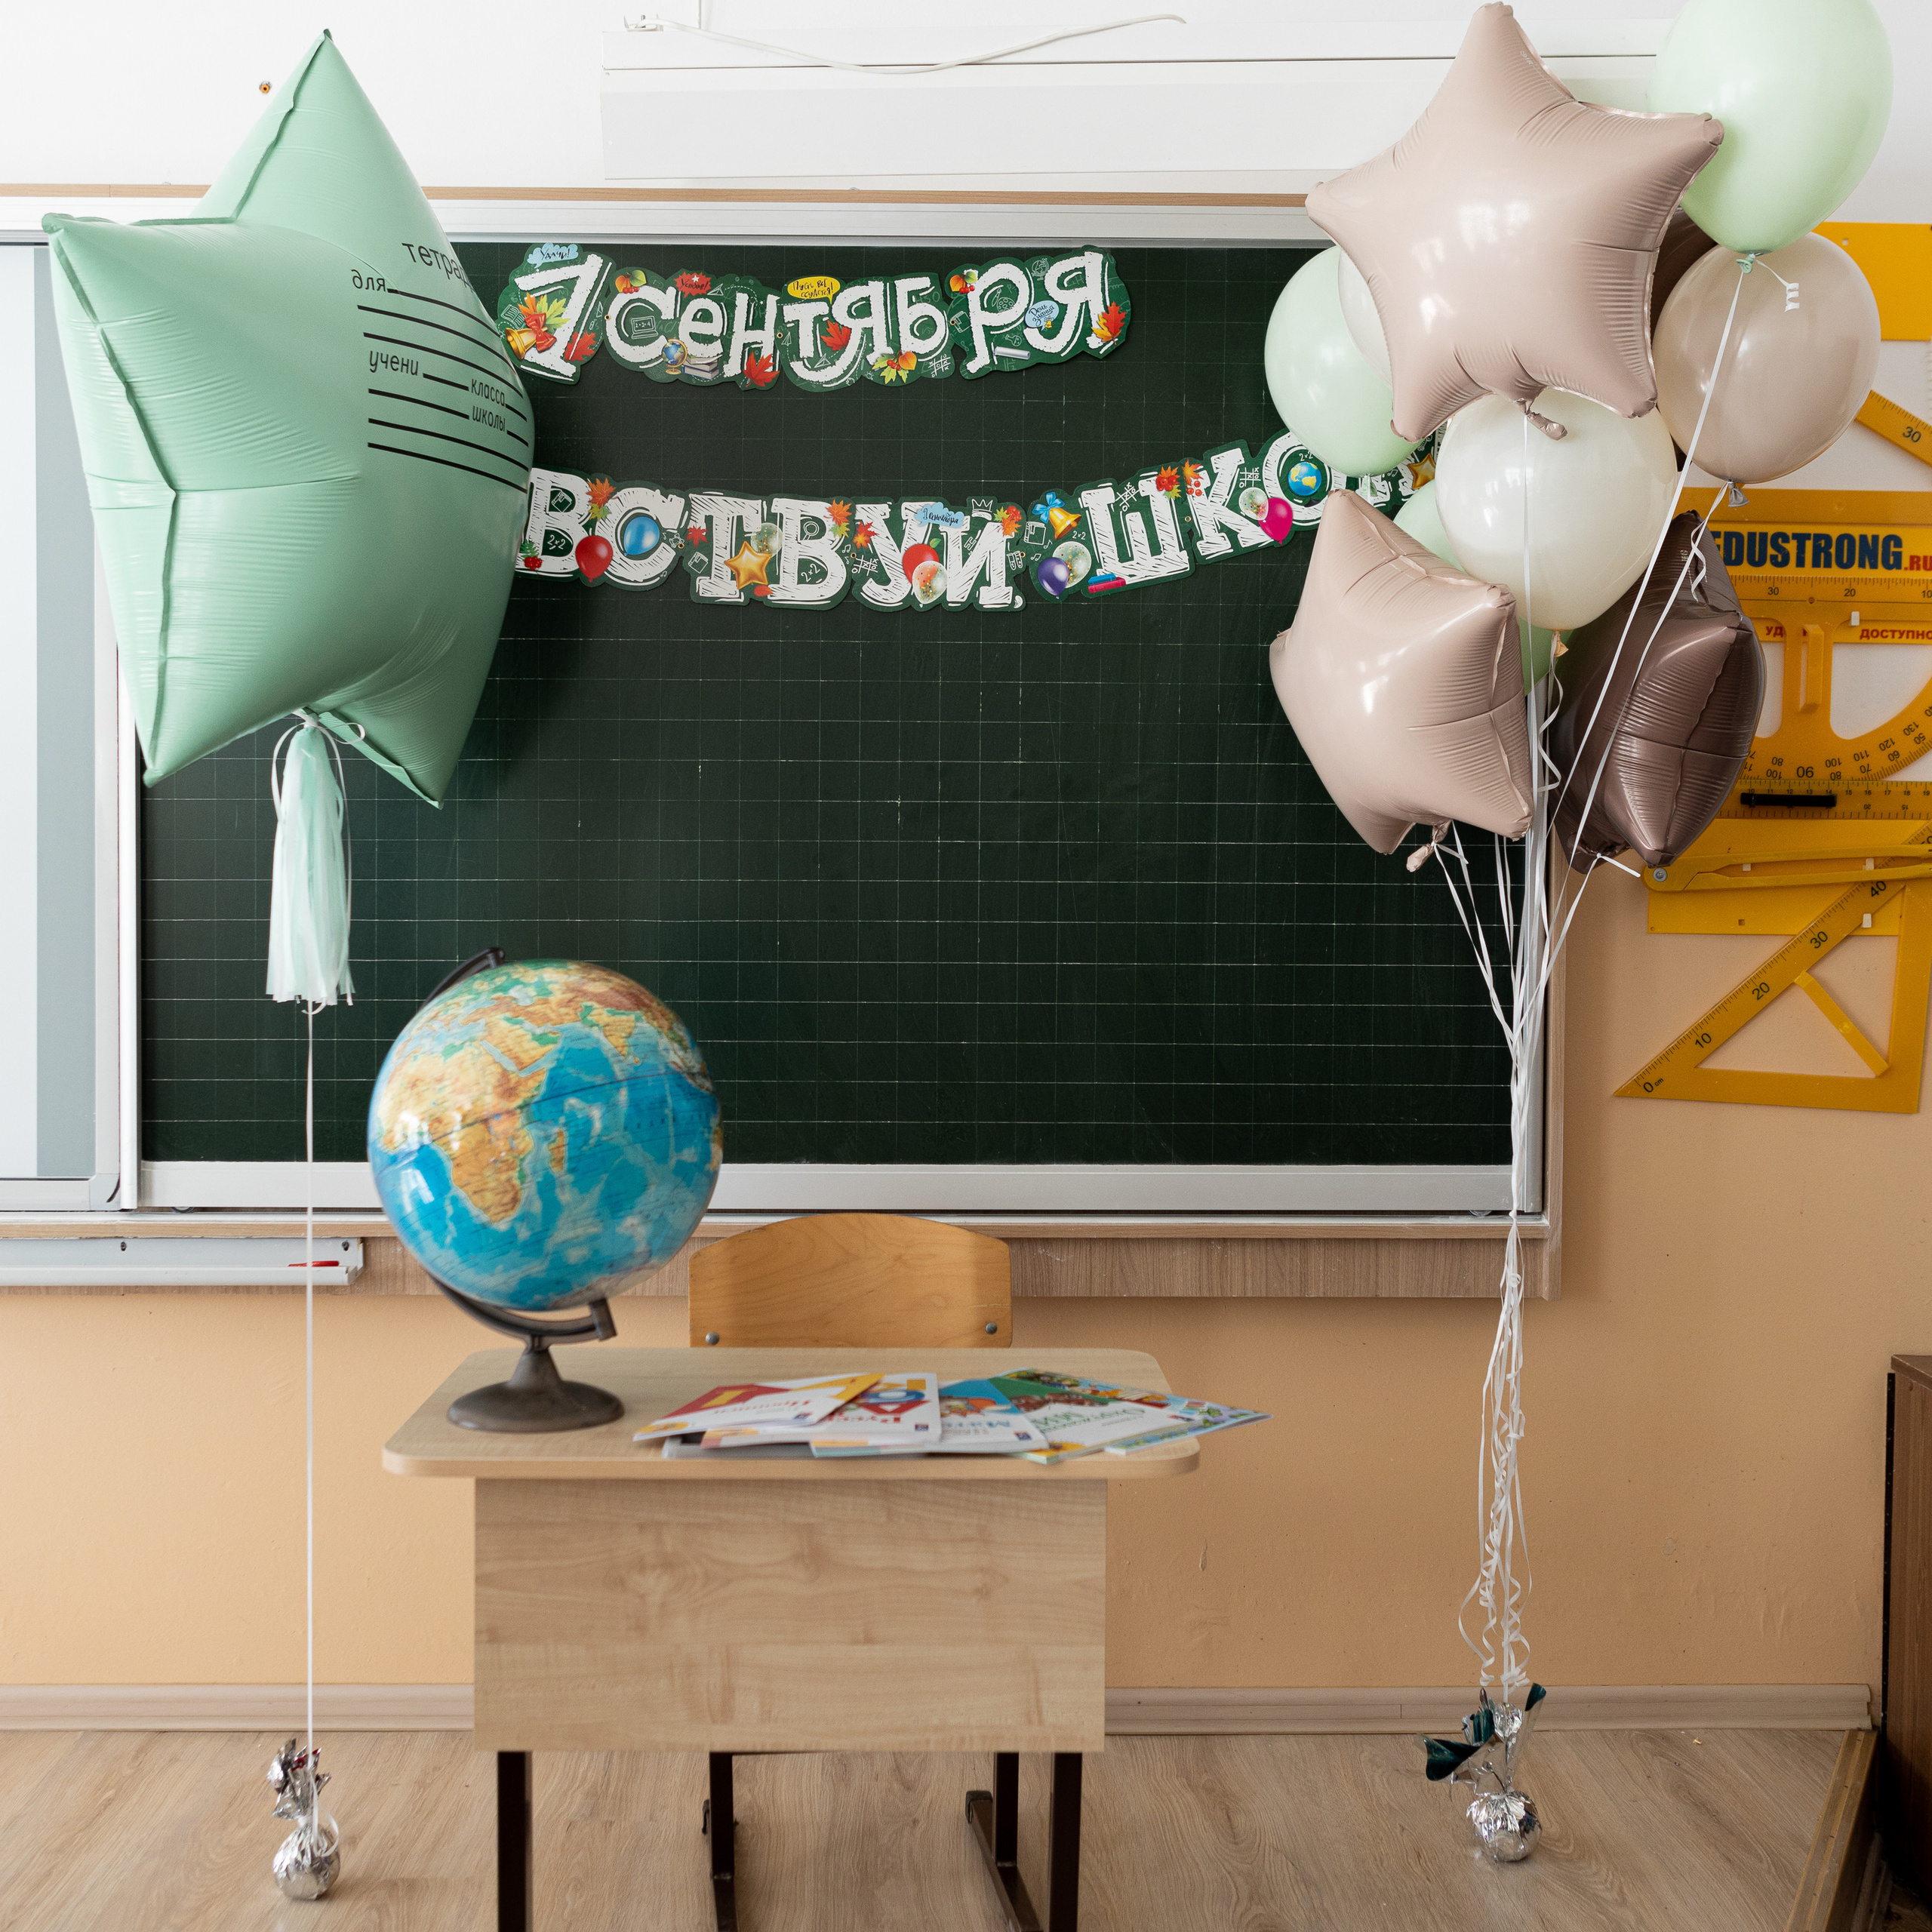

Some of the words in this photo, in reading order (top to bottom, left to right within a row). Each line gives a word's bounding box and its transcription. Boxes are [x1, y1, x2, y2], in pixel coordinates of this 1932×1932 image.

[351, 269, 386, 292] для
[1029, 304, 1048, 316] День
[369, 350, 419, 376] учени
[472, 378, 506, 407] класса
[472, 405, 506, 432] школы
[1902, 426, 1922, 443] 30
[1767, 586, 1780, 596] 30
[1844, 588, 1857, 598] 20
[1921, 589, 1932, 598] 10
[1860, 628, 1932, 640] ДОСТУПНО
[1903, 721, 1919, 737] 130
[1878, 737, 1895, 752] 120
[1913, 733, 1926, 745] 50
[1853, 749, 1869, 761] 110
[1887, 750, 1900, 762] 60
[1771, 756, 1784, 767] 80
[1825, 757, 1841, 768] 100
[1766, 768, 1783, 780] 100
[1796, 765, 1814, 779] 90
[1859, 763, 1872, 774] 70
[1830, 771, 1841, 781] 80
[1643, 1081, 1654, 1093] 0
[1654, 1078, 1665, 1087] cm
[1694, 1032, 1712, 1049] 10
[1751, 981, 1770, 1001] 20
[1809, 930, 1829, 949] 30
[1869, 879, 1887, 898] 40
